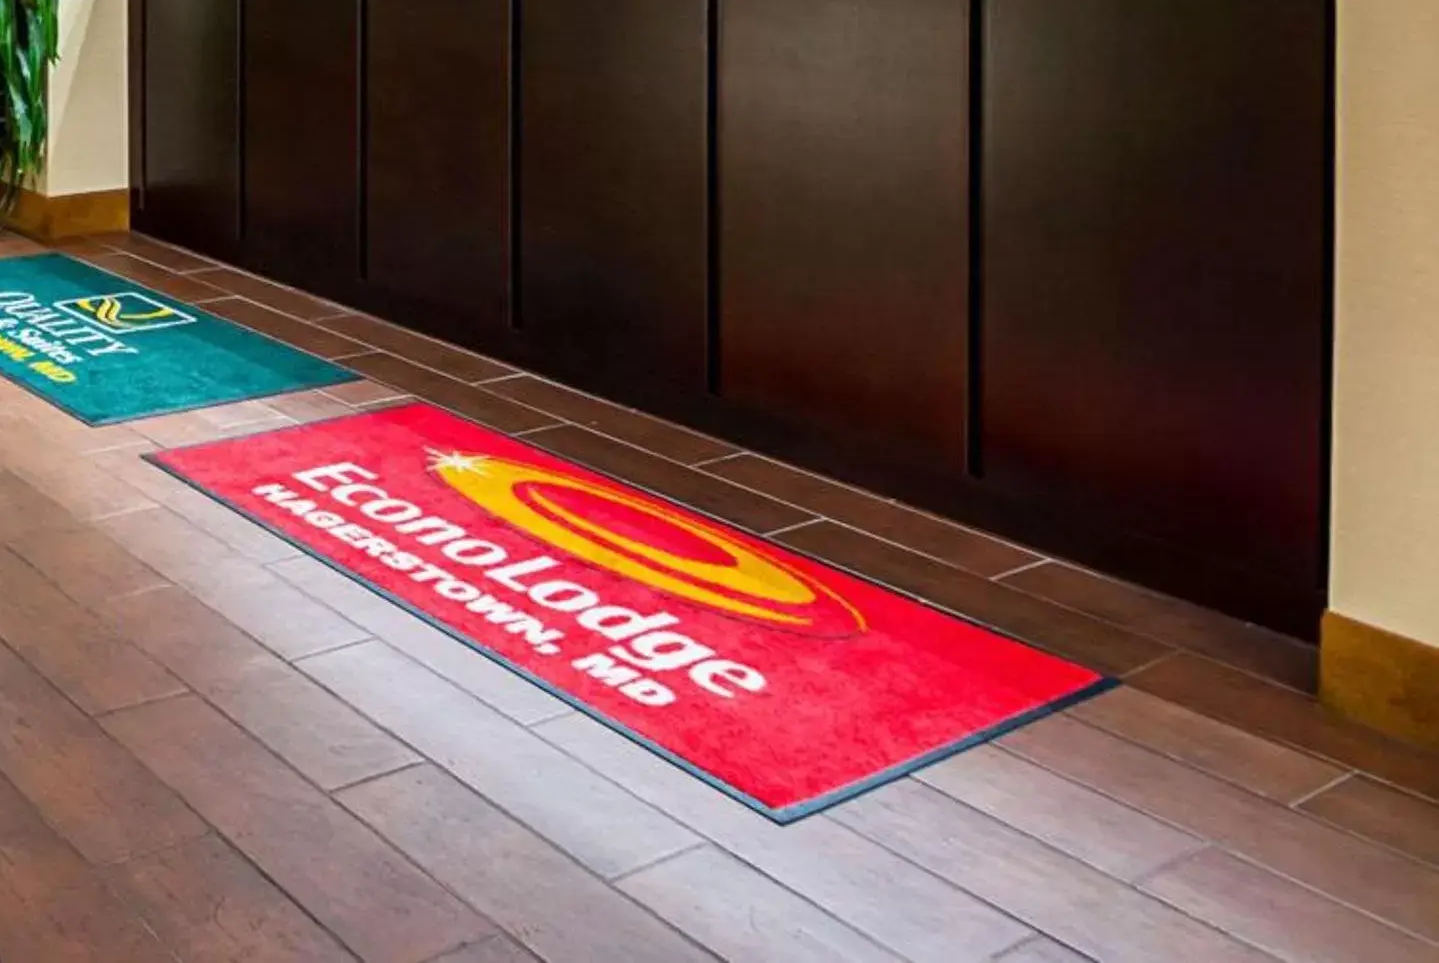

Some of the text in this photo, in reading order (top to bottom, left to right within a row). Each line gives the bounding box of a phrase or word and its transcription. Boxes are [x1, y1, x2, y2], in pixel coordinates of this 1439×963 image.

[7, 327, 84, 365] Suites
[28, 361, 77, 383] MD
[252, 483, 677, 706] HAGERSTOWN, MD
